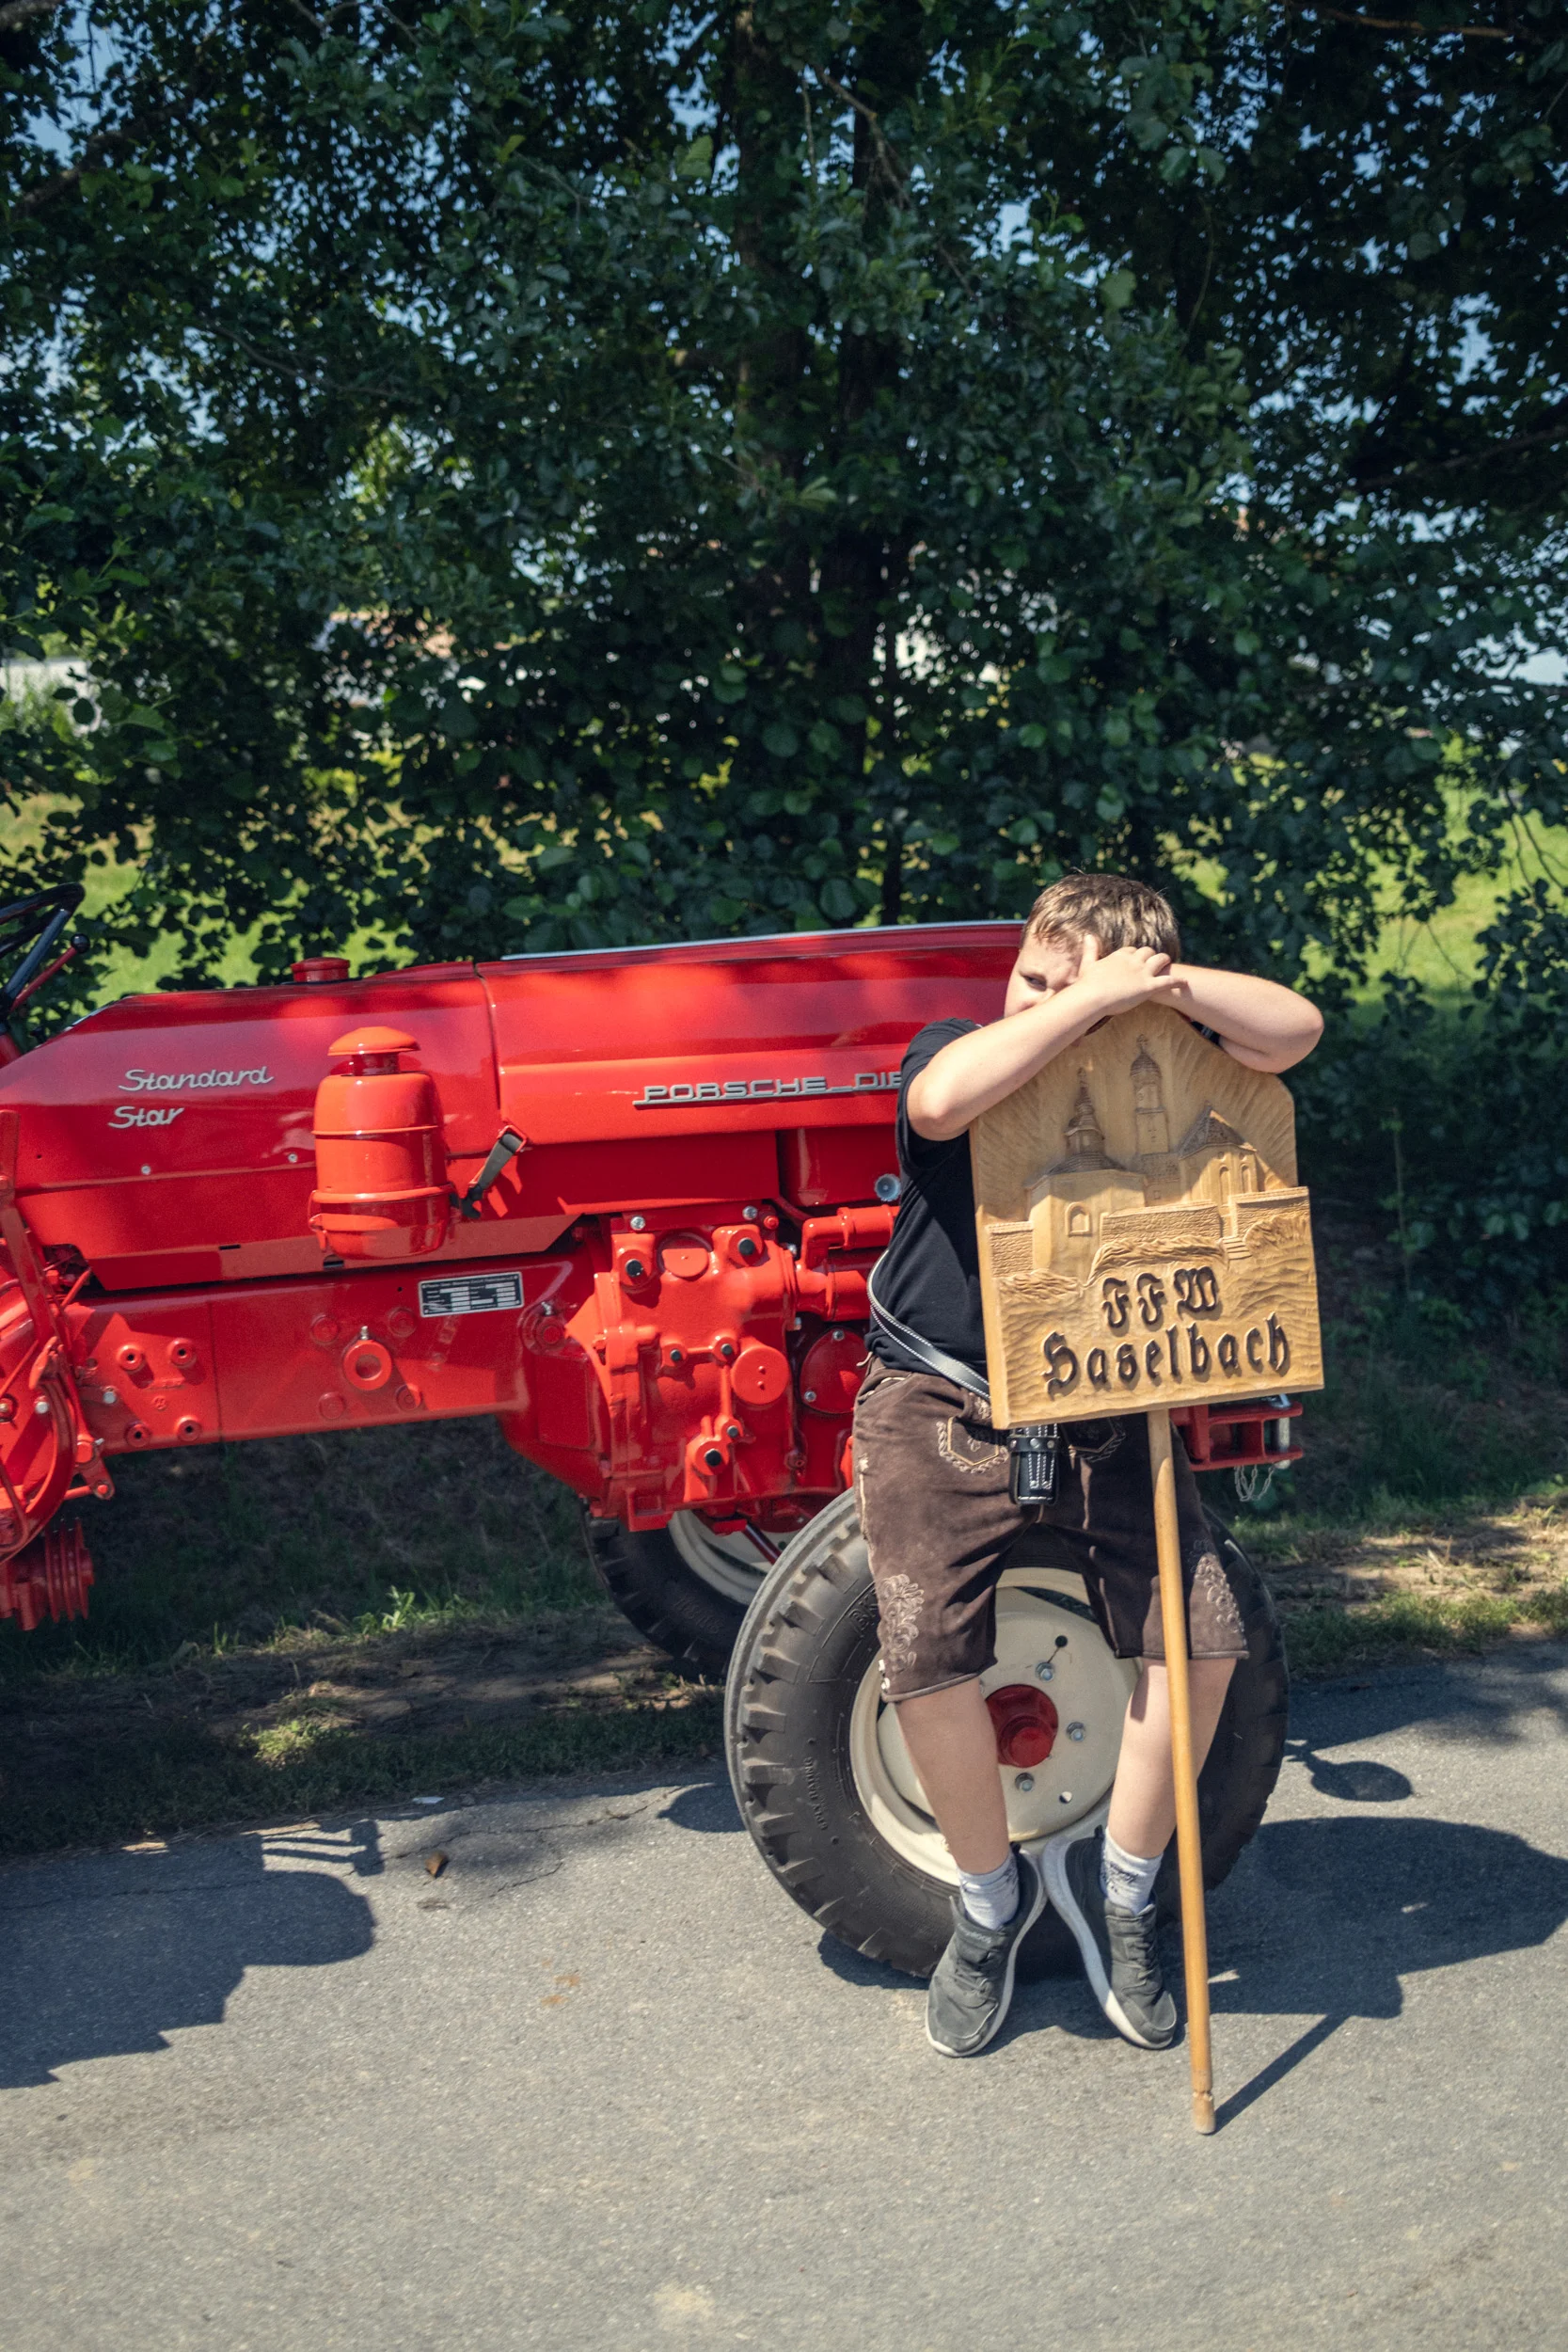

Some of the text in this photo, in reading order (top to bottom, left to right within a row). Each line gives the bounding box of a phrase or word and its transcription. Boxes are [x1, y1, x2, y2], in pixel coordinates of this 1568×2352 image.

[119, 1066, 274, 1091] Standard
[643, 1076, 827, 1103] PORSCHE
[107, 1105, 184, 1129] Star
[1101, 1265, 1220, 1328] FFW
[1041, 1311, 1290, 1399] Haselbach
